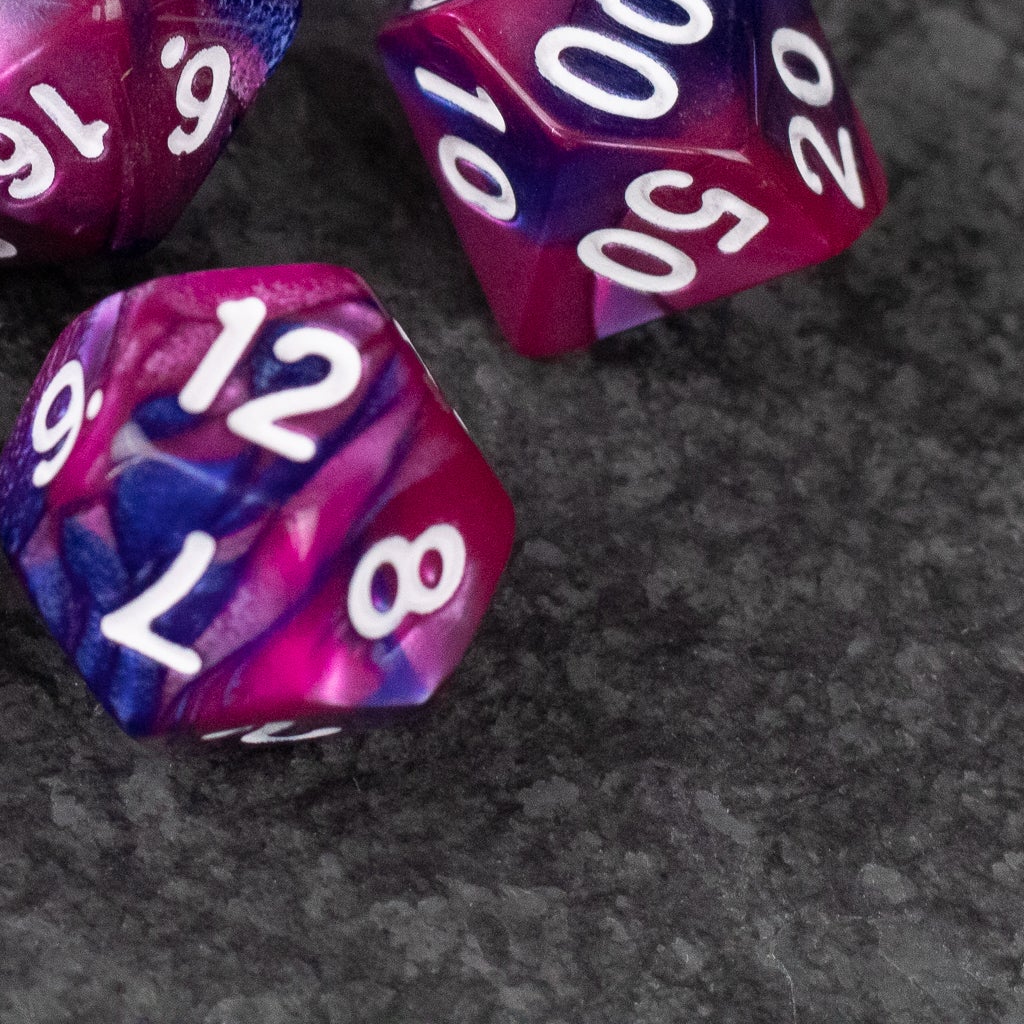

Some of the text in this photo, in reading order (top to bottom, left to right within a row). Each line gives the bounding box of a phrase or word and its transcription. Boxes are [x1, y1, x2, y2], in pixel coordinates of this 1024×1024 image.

[413, 67, 517, 221] 10
[770, 27, 865, 209] 20
[576, 169, 769, 294] 50
[178, 296, 363, 462] 12
[100, 531, 216, 676] 7
[347, 523, 467, 640] 8
